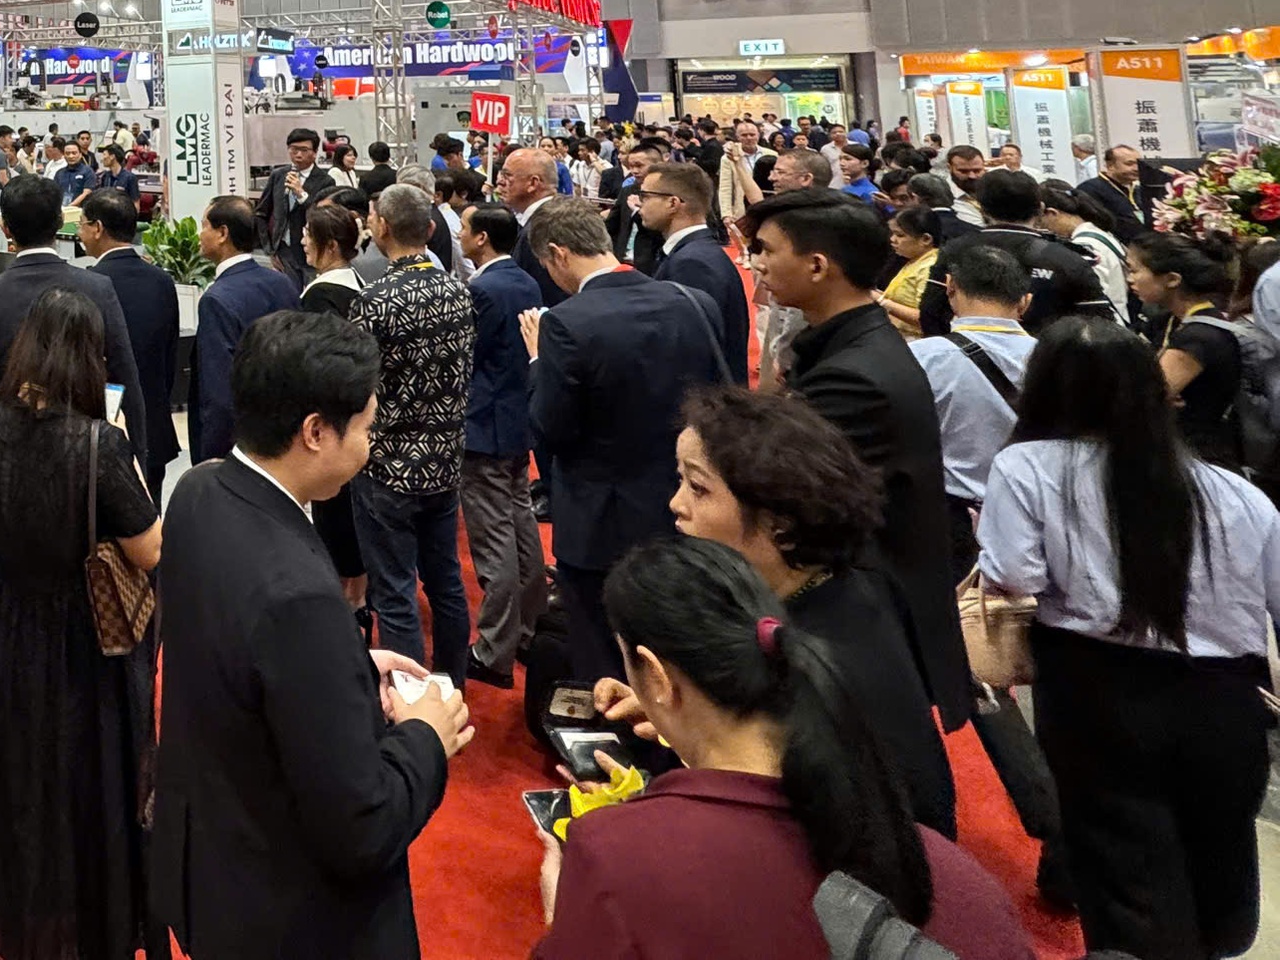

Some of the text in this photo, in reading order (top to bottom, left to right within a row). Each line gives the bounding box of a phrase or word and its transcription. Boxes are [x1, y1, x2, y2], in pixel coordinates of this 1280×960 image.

[428, 12, 449, 20] Robot
[76, 20, 97, 30] Laser
[744, 43, 780, 52] EXIT
[1116, 57, 1163, 70] A511
[1022, 72, 1054, 83] A511
[475, 98, 507, 126] VIP
[176, 114, 200, 185] LMG
[200, 113, 212, 186] LEADERMAC
